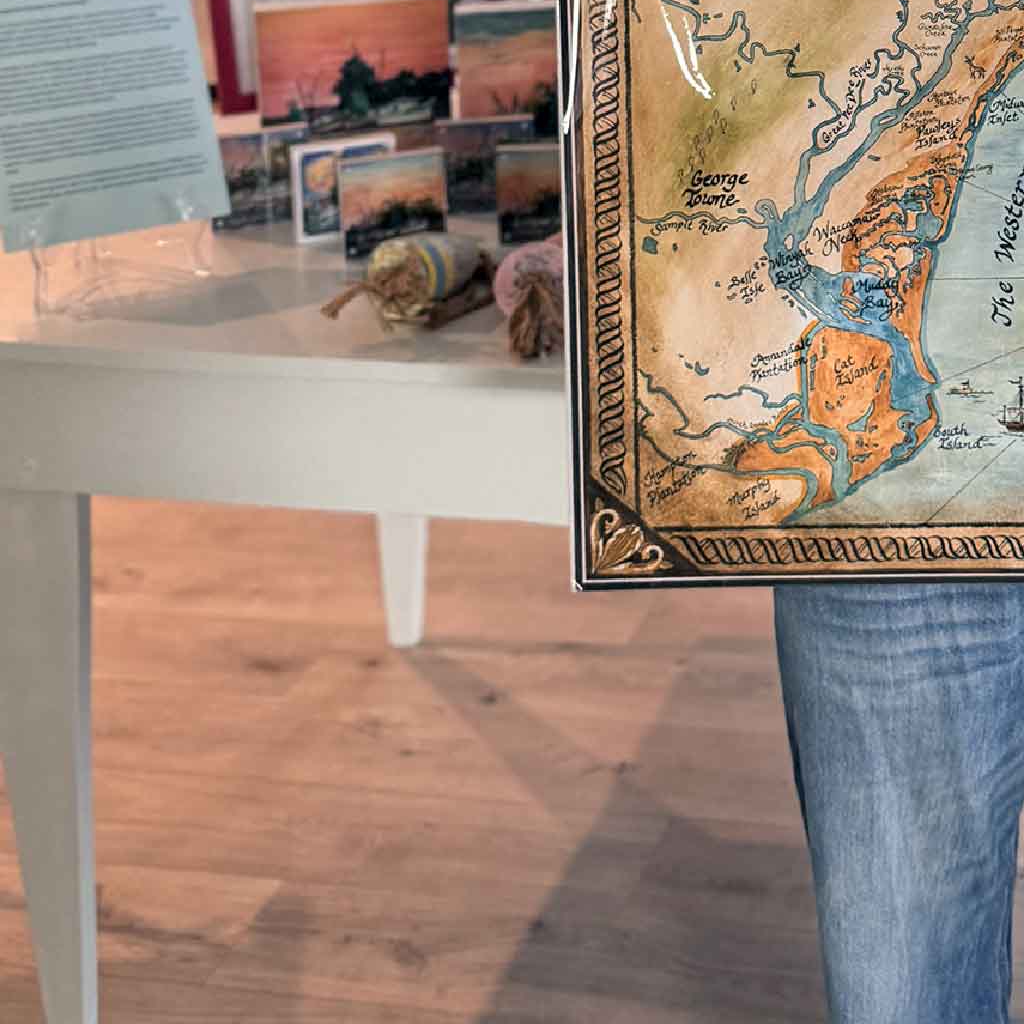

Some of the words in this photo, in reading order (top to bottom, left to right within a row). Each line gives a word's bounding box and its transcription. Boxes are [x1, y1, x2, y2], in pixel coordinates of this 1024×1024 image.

[987, 112, 1020, 126] Inlet
[691, 169, 750, 192] George
[682, 187, 740, 208] Towne
[699, 219, 728, 235] River
[812, 211, 880, 242] Waccamaw
[822, 230, 863, 256] Neck
[727, 269, 757, 291] Belle
[740, 282, 766, 300] Isle
[992, 280, 1015, 327] The
[834, 355, 855, 374] Cat
[834, 355, 879, 387] Island
[938, 436, 983, 450] Island
[742, 490, 781, 520] Island
